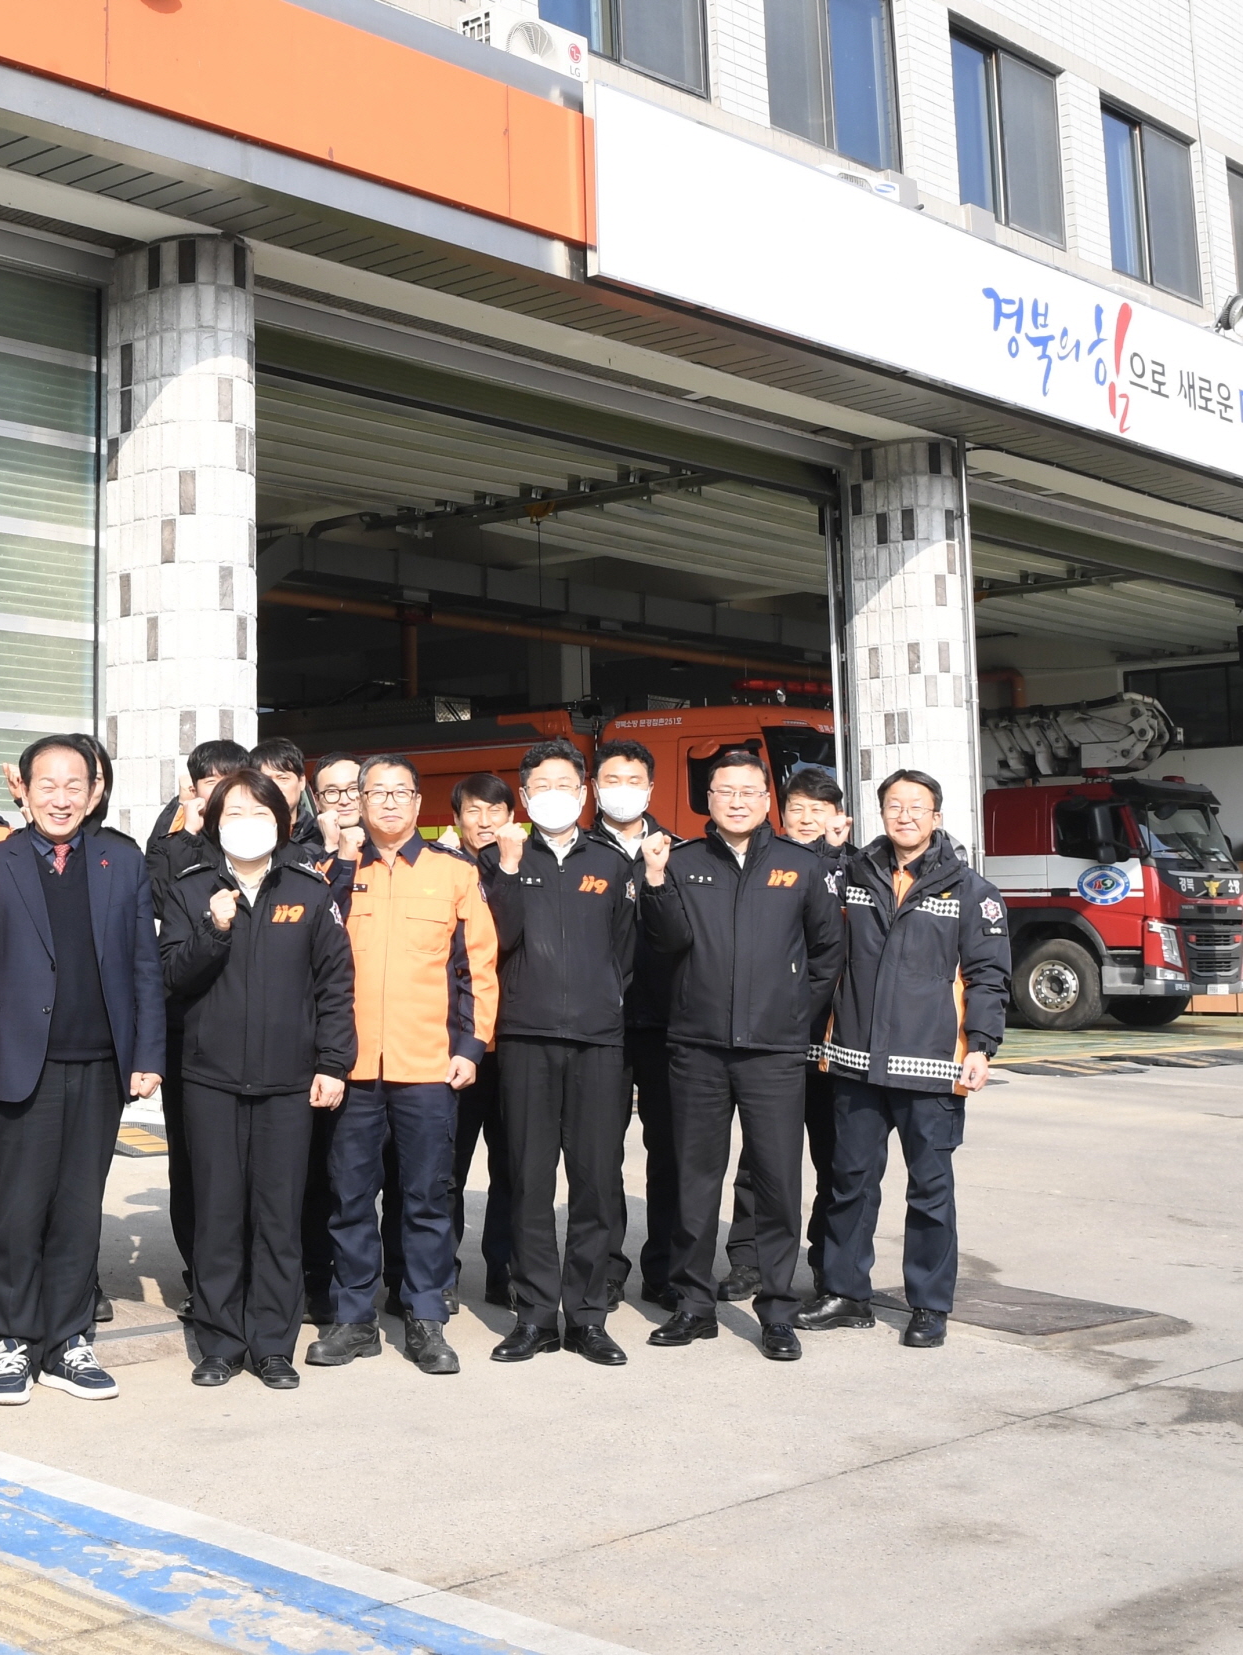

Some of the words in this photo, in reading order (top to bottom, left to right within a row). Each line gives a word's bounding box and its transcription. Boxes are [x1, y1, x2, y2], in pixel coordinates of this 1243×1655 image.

[569, 65, 581, 77] LG
[1177, 370, 1234, 423] 새로운
[578, 877, 609, 895] 119
[767, 870, 799, 887] 119
[1178, 877, 1195, 892] 경북
[1227, 879, 1240, 895] 소방
[271, 905, 305, 923] 119
